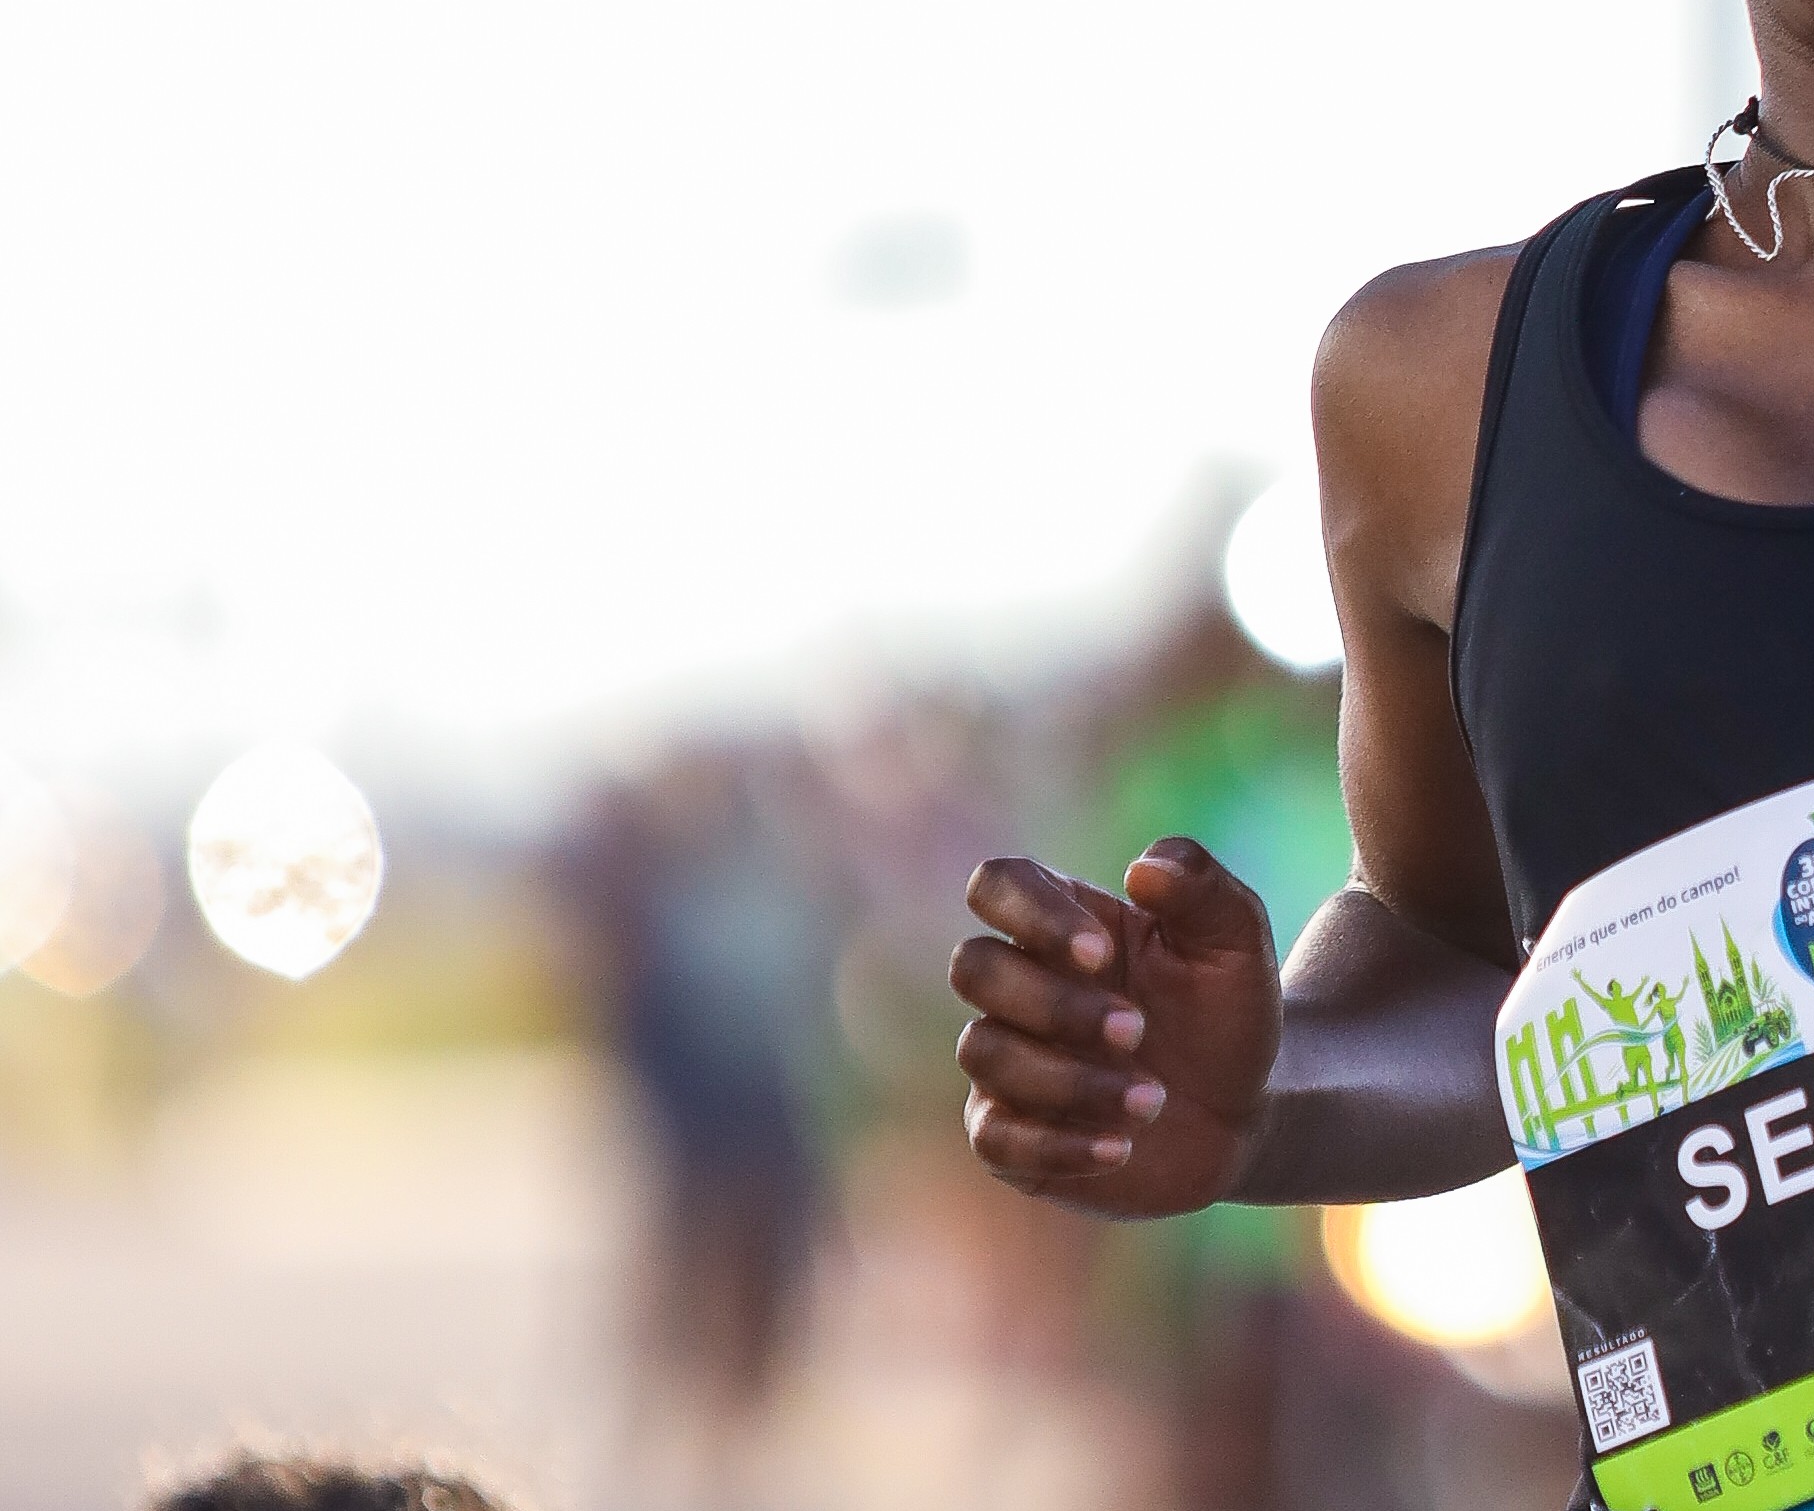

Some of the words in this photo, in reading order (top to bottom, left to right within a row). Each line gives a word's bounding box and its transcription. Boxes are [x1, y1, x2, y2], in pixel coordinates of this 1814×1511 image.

[1537, 936, 1586, 973] Energia
[1590, 920, 1617, 946] que
[1620, 906, 1653, 930] vem
[1657, 894, 1677, 914] do
[1681, 865, 1742, 904] campo!
[1577, 1328, 1645, 1362] RESULTADO
